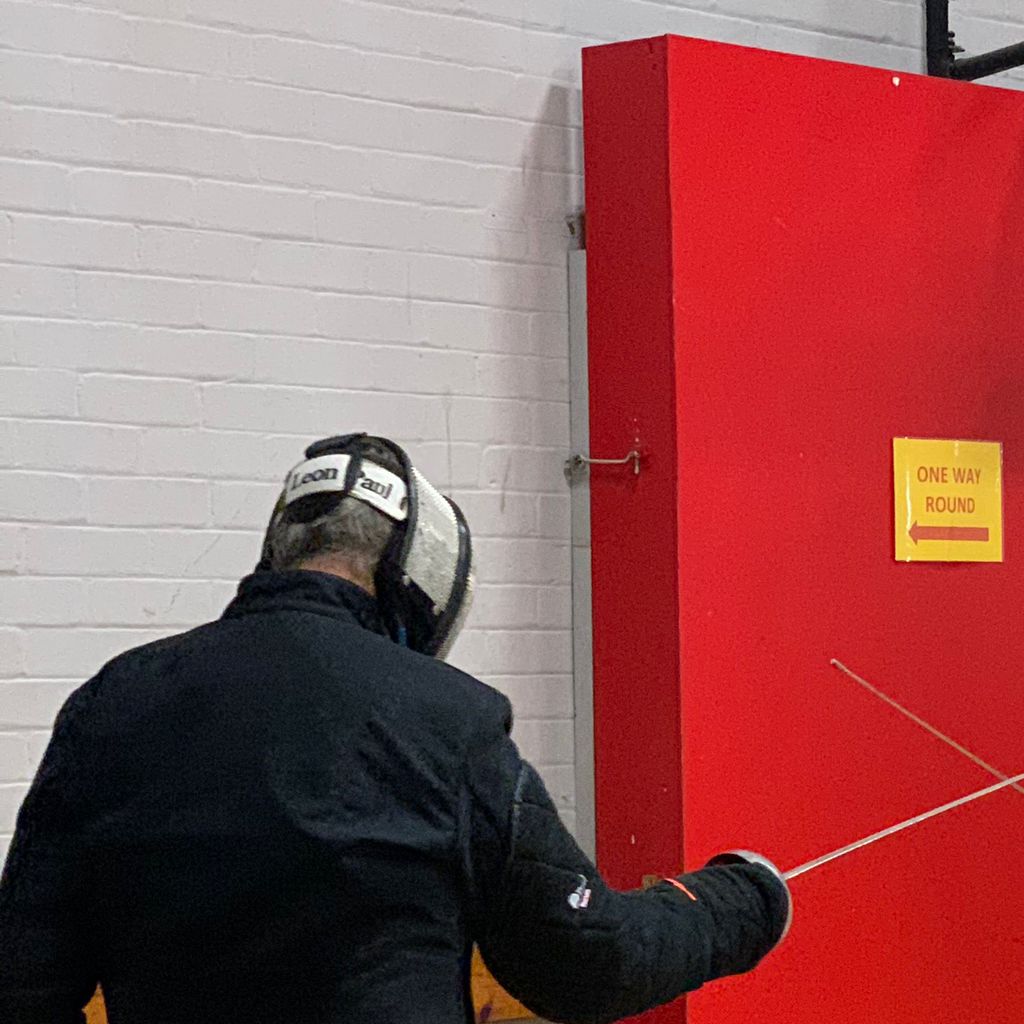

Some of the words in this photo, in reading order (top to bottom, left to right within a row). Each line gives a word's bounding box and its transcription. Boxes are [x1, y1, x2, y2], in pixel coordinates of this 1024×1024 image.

[291, 468, 339, 490] Leon
[917, 466, 948, 483] ONE
[952, 467, 981, 484] WAY
[926, 496, 975, 513] ROUND
